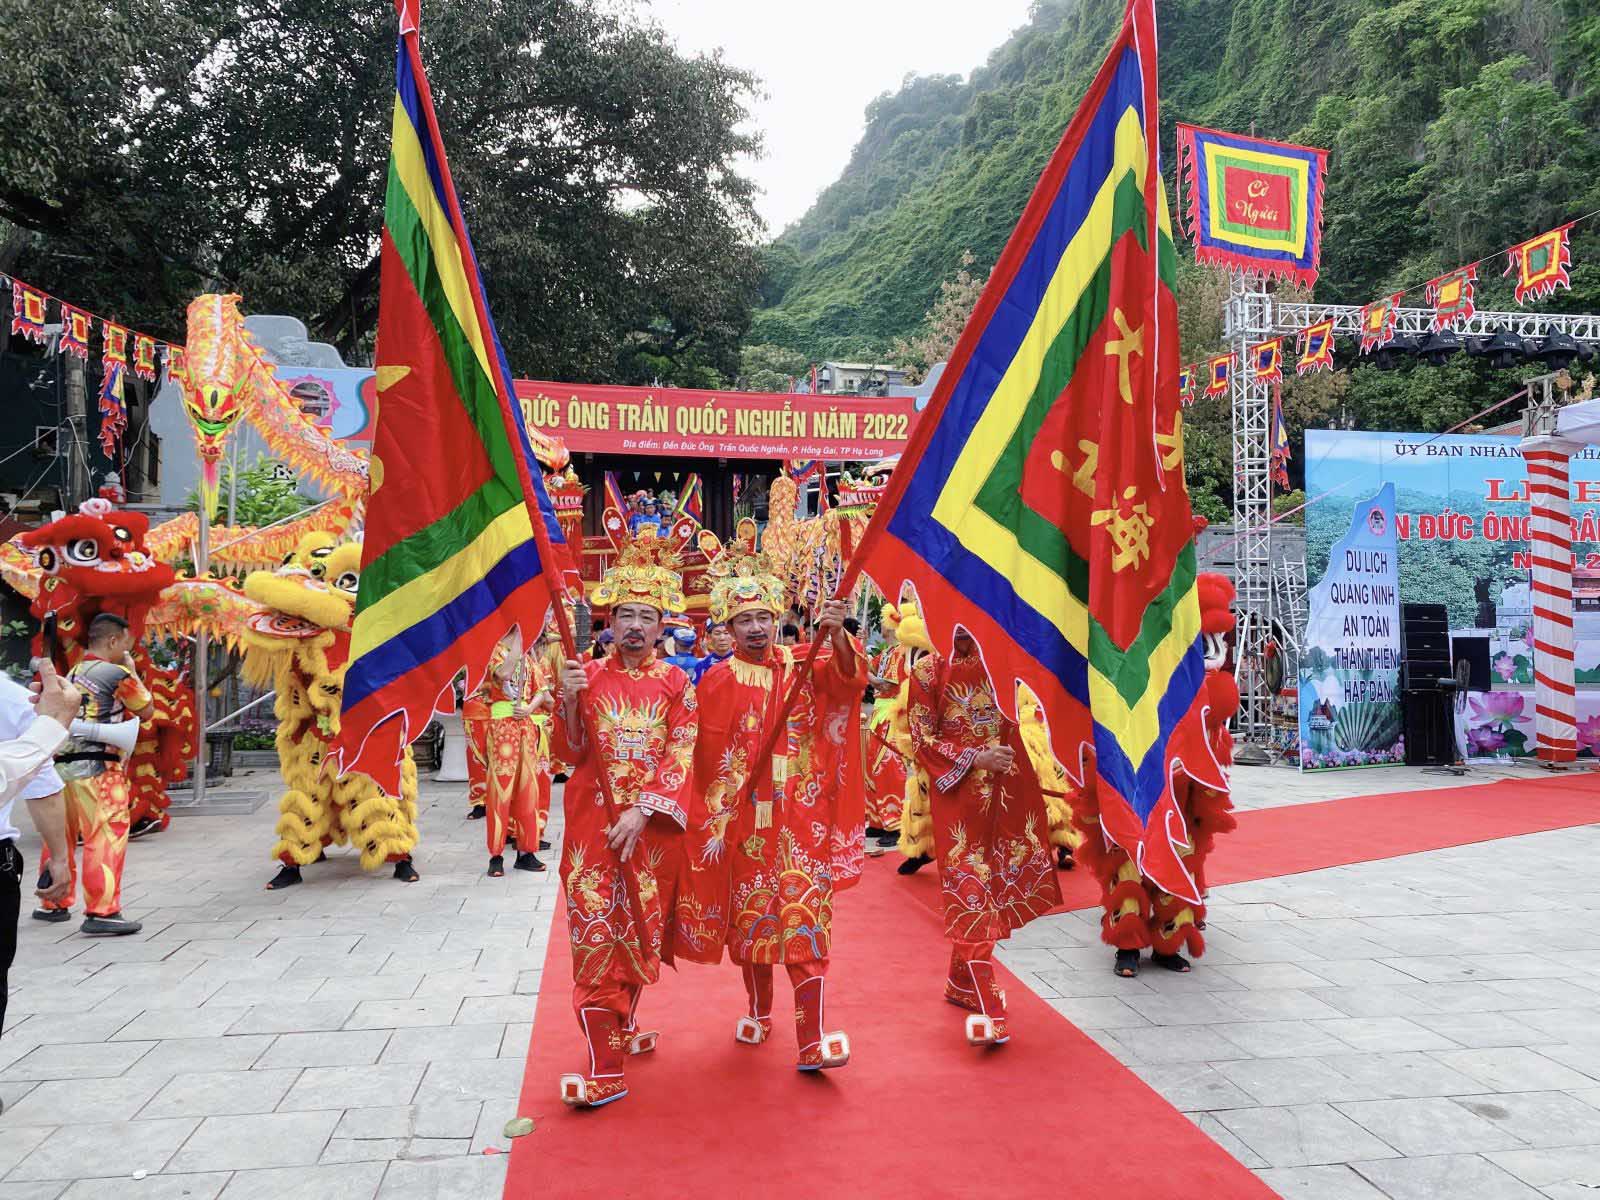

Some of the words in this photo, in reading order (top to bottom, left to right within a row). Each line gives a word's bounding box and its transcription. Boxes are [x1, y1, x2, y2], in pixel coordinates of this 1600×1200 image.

[520, 393, 560, 428] ĐỨC
[567, 395, 610, 431] ÔNG
[616, 395, 669, 433] TRẦN
[676, 398, 728, 436] QUỐC
[735, 400, 806, 438] NGHIỄN
[813, 406, 857, 439] NĂM
[863, 413, 908, 440] 2022
[698, 441, 714, 452] Ông
[865, 448, 884, 457] Long
[1395, 439, 1421, 456] ỦY
[1426, 444, 1464, 457] BAN
[1470, 443, 1521, 458] NHÂN
[1418, 508, 1473, 541] ĐỨC
[1346, 550, 1361, 572] DU
[1364, 551, 1388, 579] LỊCH
[1330, 578, 1369, 605] QUẢNG
[1371, 584, 1395, 606] NINH
[1343, 615, 1358, 637] AN
[1361, 609, 1390, 638] TOÀN
[1334, 641, 1364, 670] THÂN
[1367, 643, 1397, 675] THIỆN
